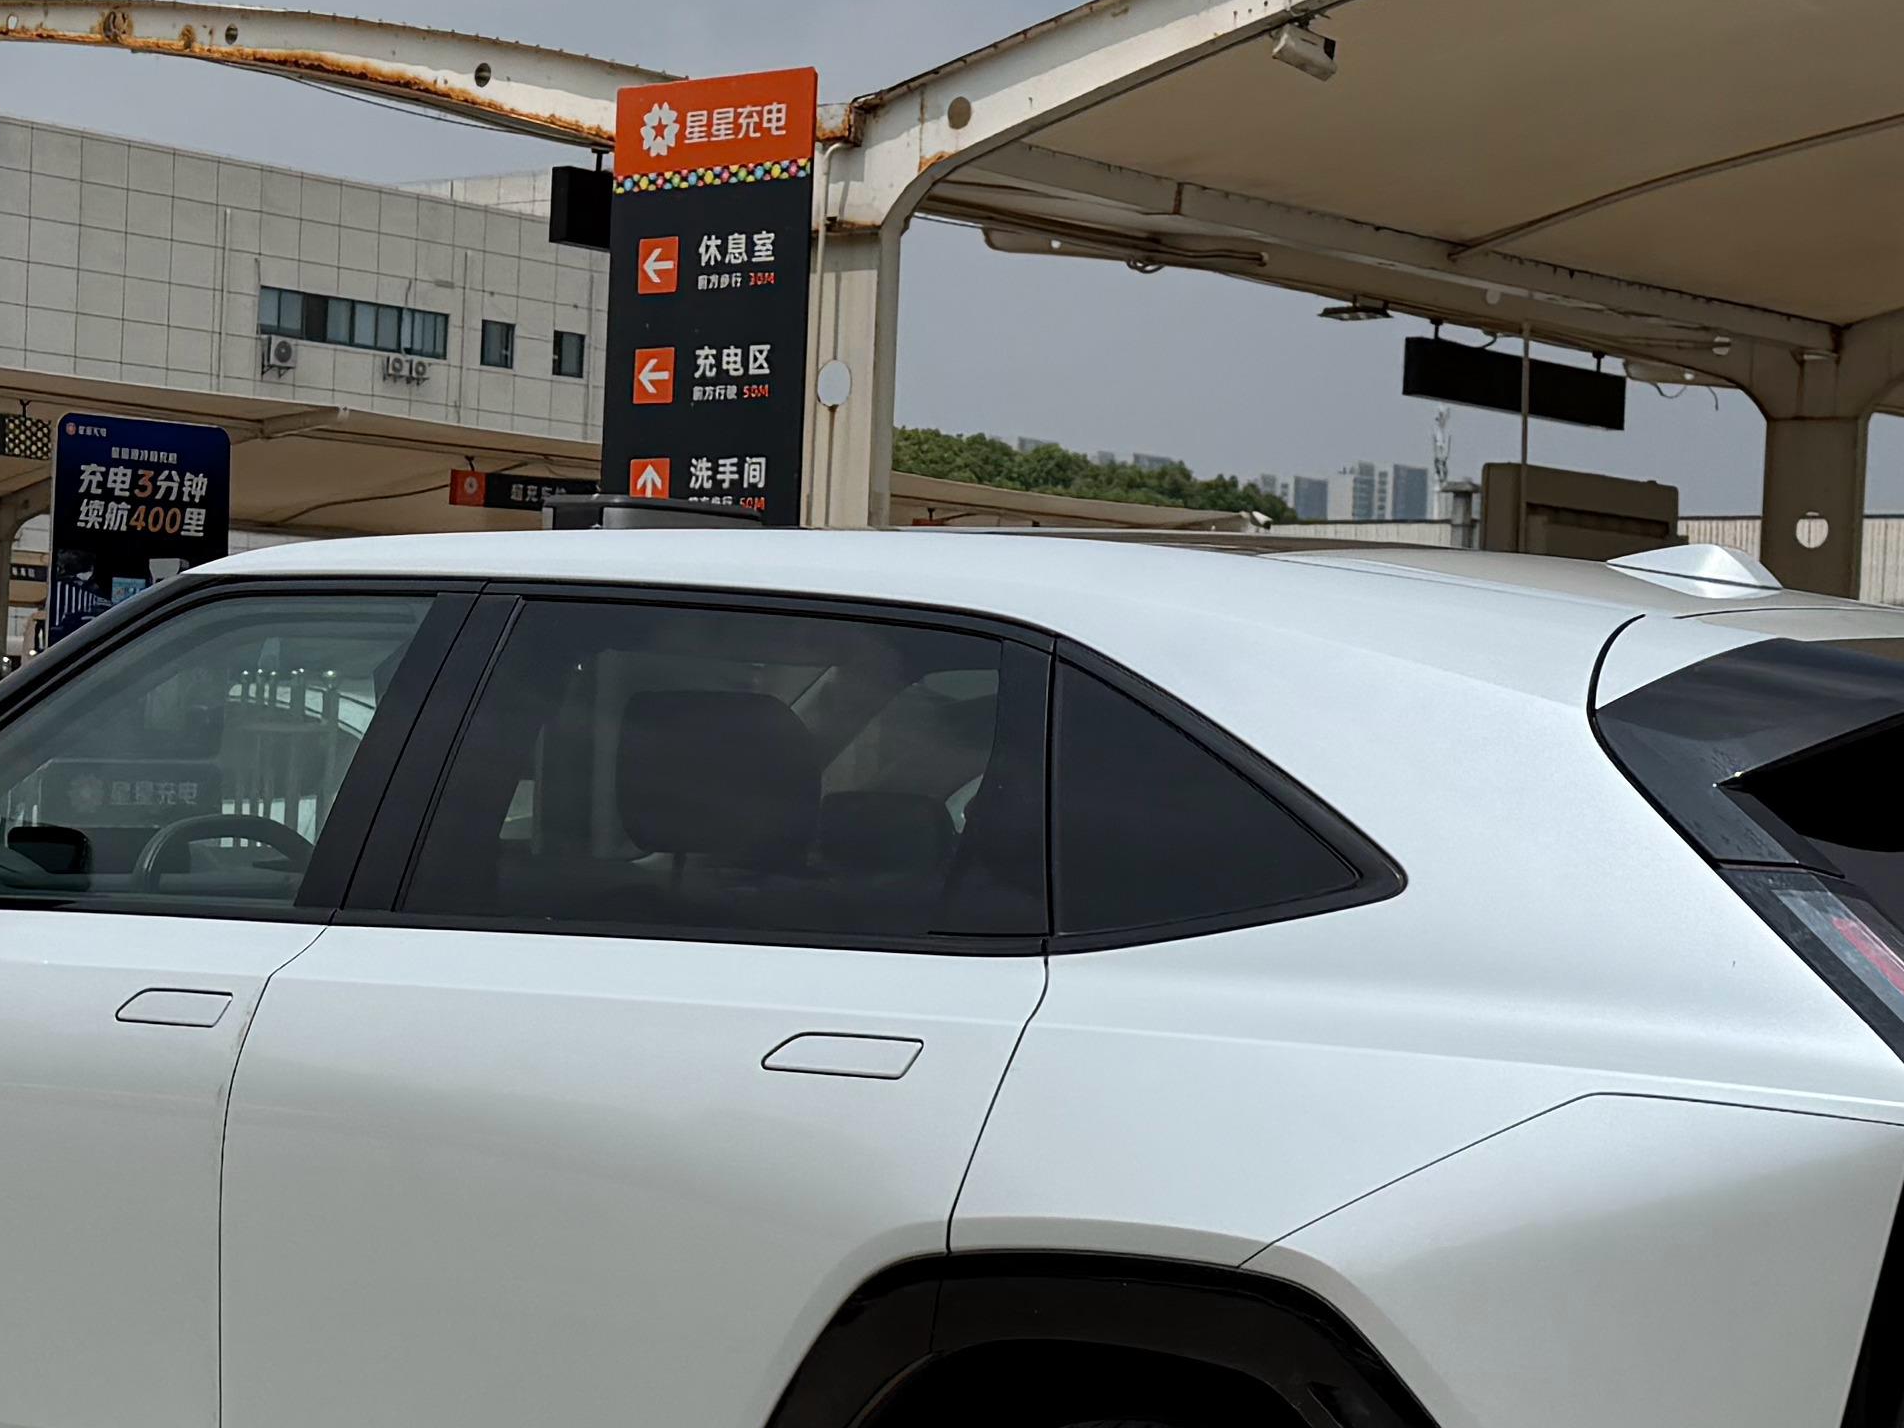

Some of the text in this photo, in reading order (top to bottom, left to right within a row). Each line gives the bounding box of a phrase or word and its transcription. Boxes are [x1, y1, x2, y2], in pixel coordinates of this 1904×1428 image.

[684, 102, 787, 144] 星星充电
[698, 230, 776, 267] 休息室
[694, 345, 771, 378] 充电区
[78, 463, 208, 503] 充电3分钟
[689, 456, 767, 490] 洗手间
[77, 498, 206, 537] 续航400里
